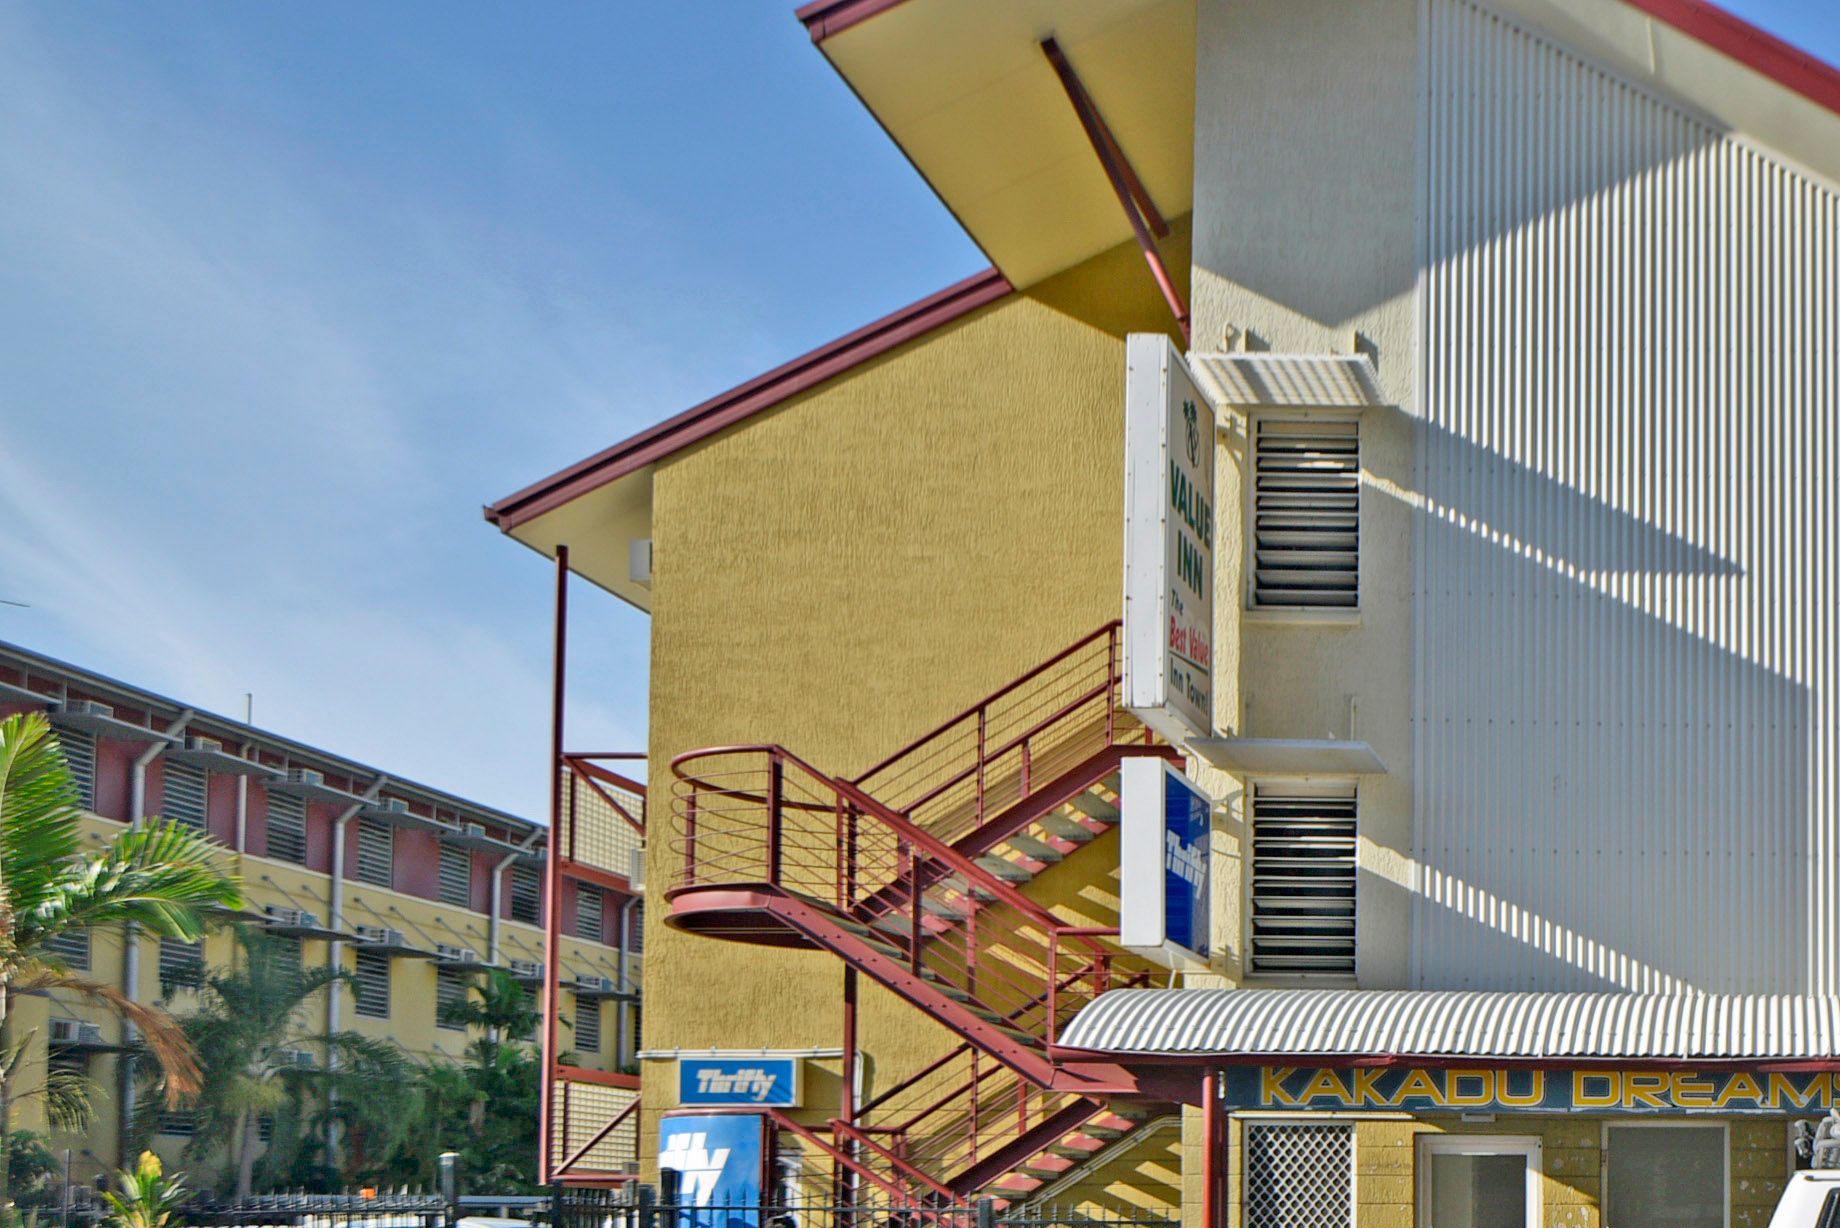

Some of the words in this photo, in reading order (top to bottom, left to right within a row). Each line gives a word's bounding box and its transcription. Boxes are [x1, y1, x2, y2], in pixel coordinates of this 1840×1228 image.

[1170, 458, 1211, 550] VALUE
[1177, 528, 1204, 600] INN
[1172, 588, 1184, 617] The
[1170, 615, 1187, 654] Best
[1189, 626, 1209, 667] Value
[1170, 657, 1184, 694] Inn
[1166, 828, 1208, 900] Thrifty
[697, 1068, 777, 1102] Thrifty
[1260, 1065, 1546, 1107] KAKADU
